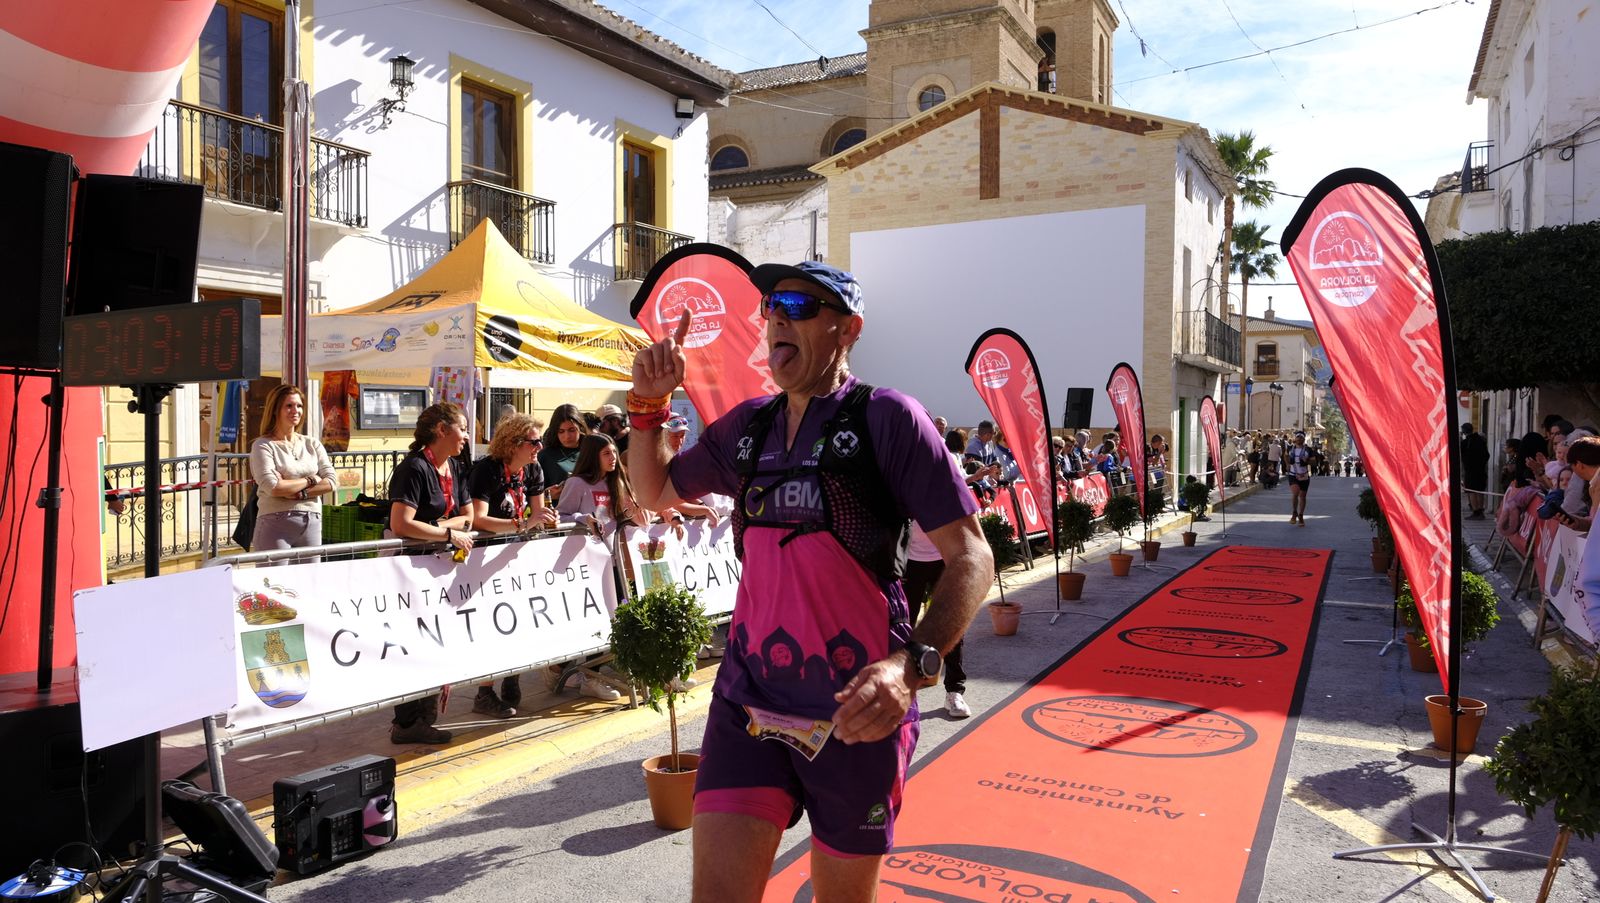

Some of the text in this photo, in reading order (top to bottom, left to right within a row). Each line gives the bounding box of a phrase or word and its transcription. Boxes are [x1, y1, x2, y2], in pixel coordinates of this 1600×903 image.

[682, 541, 730, 559] AYUNT
[330, 564, 590, 618] AYUNTAMIENTO DE
[683, 559, 740, 592] CAN
[330, 586, 602, 667] CANTORIA
[1102, 668, 1246, 688] Ayuntamiento
[1119, 665, 1204, 677] Cantoria
[977, 779, 1185, 820] Ayuntamiento
[1004, 771, 1172, 804] de Cantoria
[884, 855, 1072, 903] POLVORA
[914, 852, 1006, 877] Cantoria
